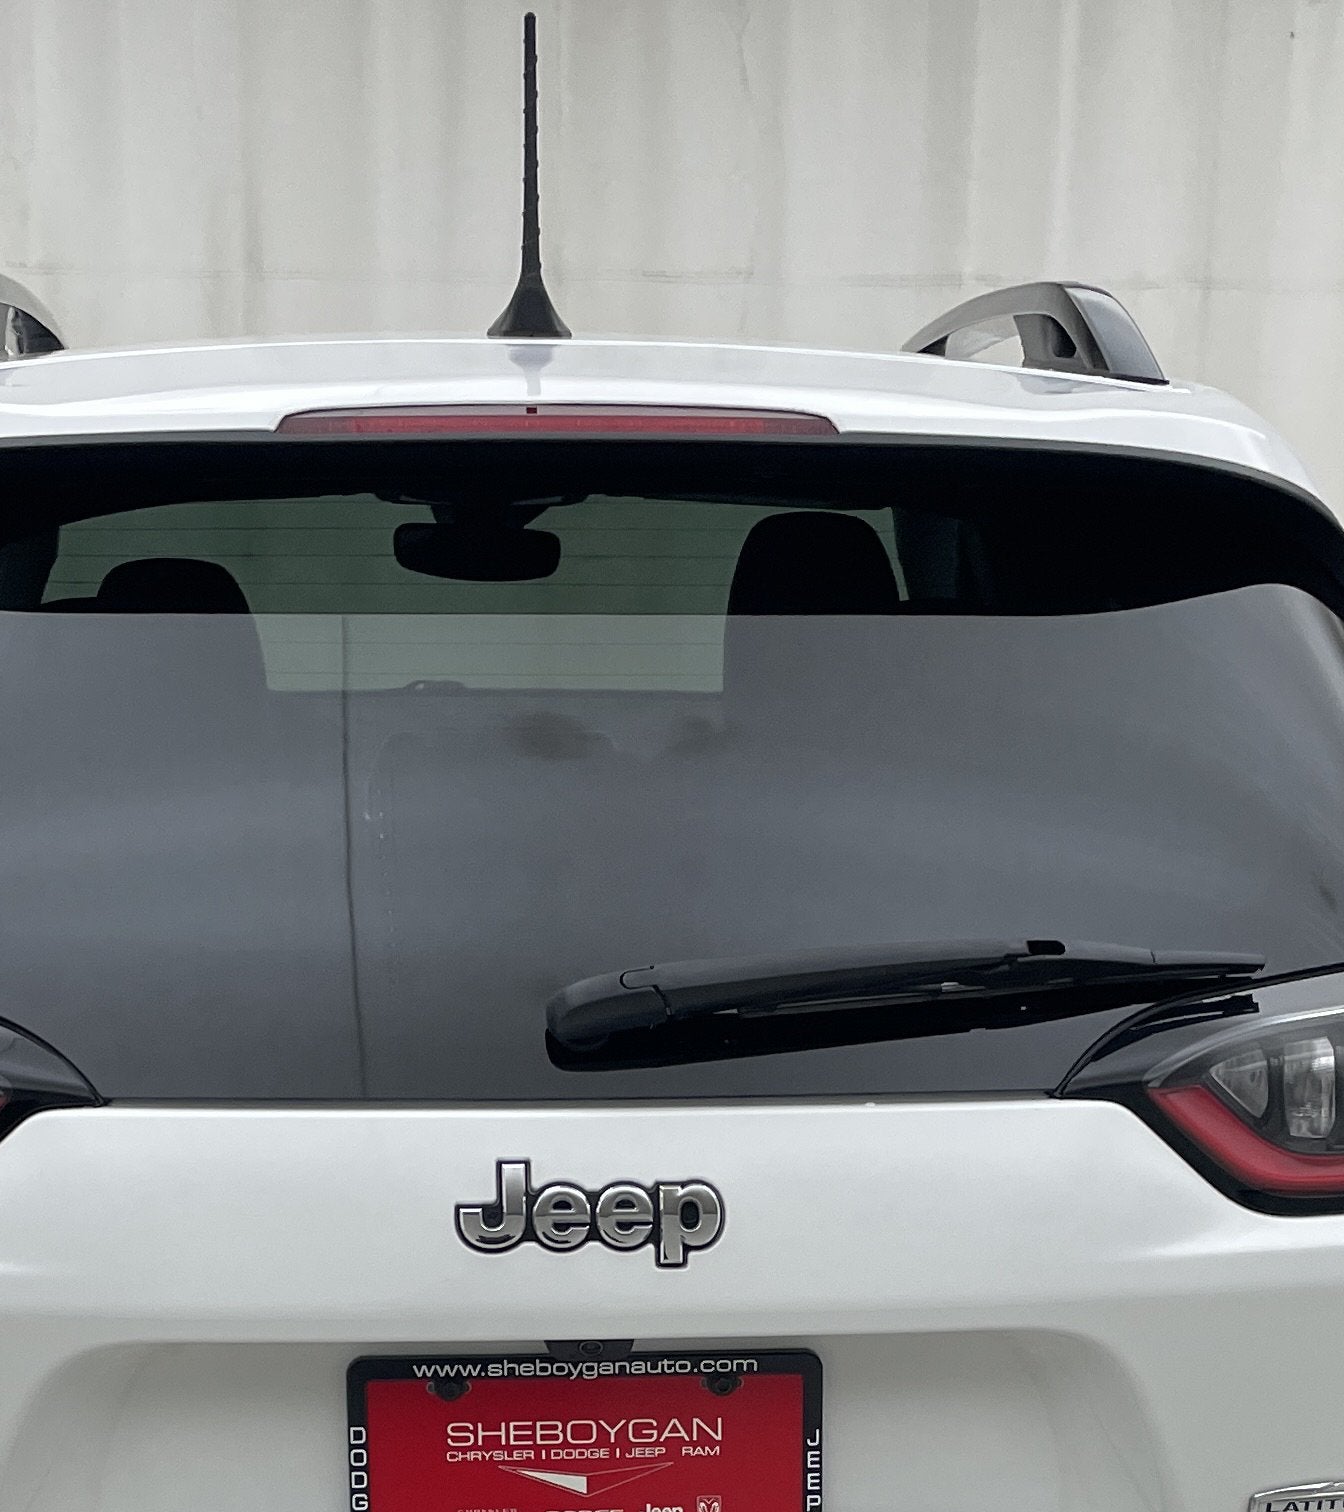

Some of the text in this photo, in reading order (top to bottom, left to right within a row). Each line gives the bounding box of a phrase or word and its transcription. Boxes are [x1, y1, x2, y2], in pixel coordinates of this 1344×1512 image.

[455, 1158, 724, 1269] Jeep
[413, 1357, 758, 1380] www.sheboyganauto.com
[446, 1417, 723, 1447] SHEBOYGAN
[446, 1446, 720, 1462] CHRYSLER DODGE JEEP RAM
[805, 1429, 822, 1512] JEEP
